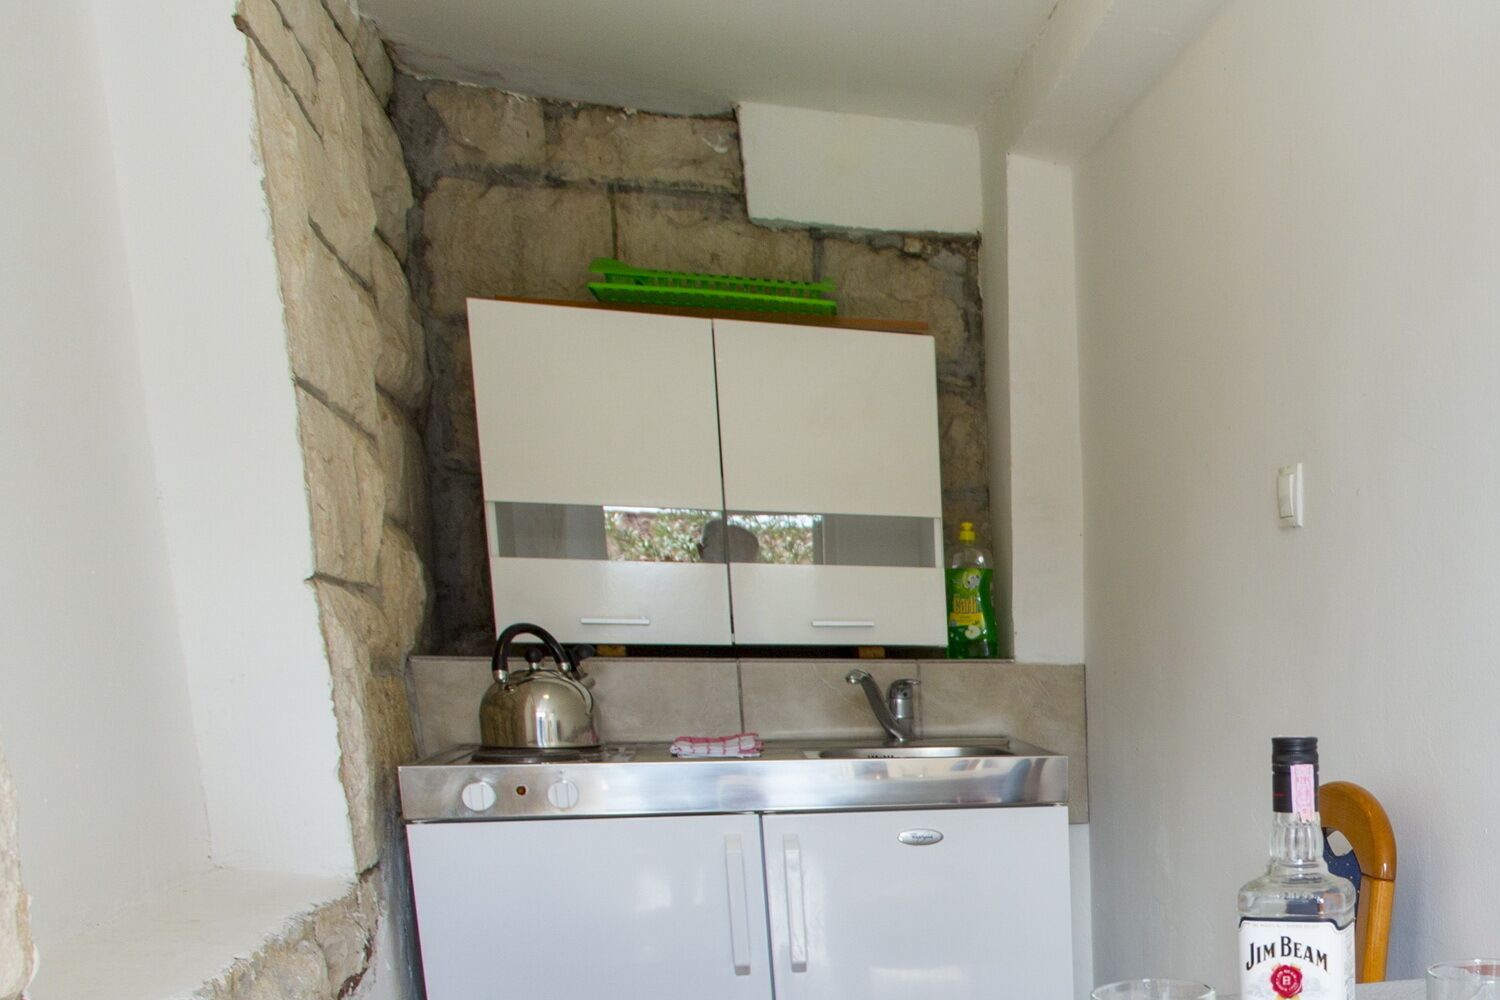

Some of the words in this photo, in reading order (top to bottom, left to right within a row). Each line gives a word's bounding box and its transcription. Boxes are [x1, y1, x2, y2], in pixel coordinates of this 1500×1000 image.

[1245, 942, 1276, 971] JIM
[1280, 935, 1328, 972] BEAM
[1282, 975, 1291, 985] B
